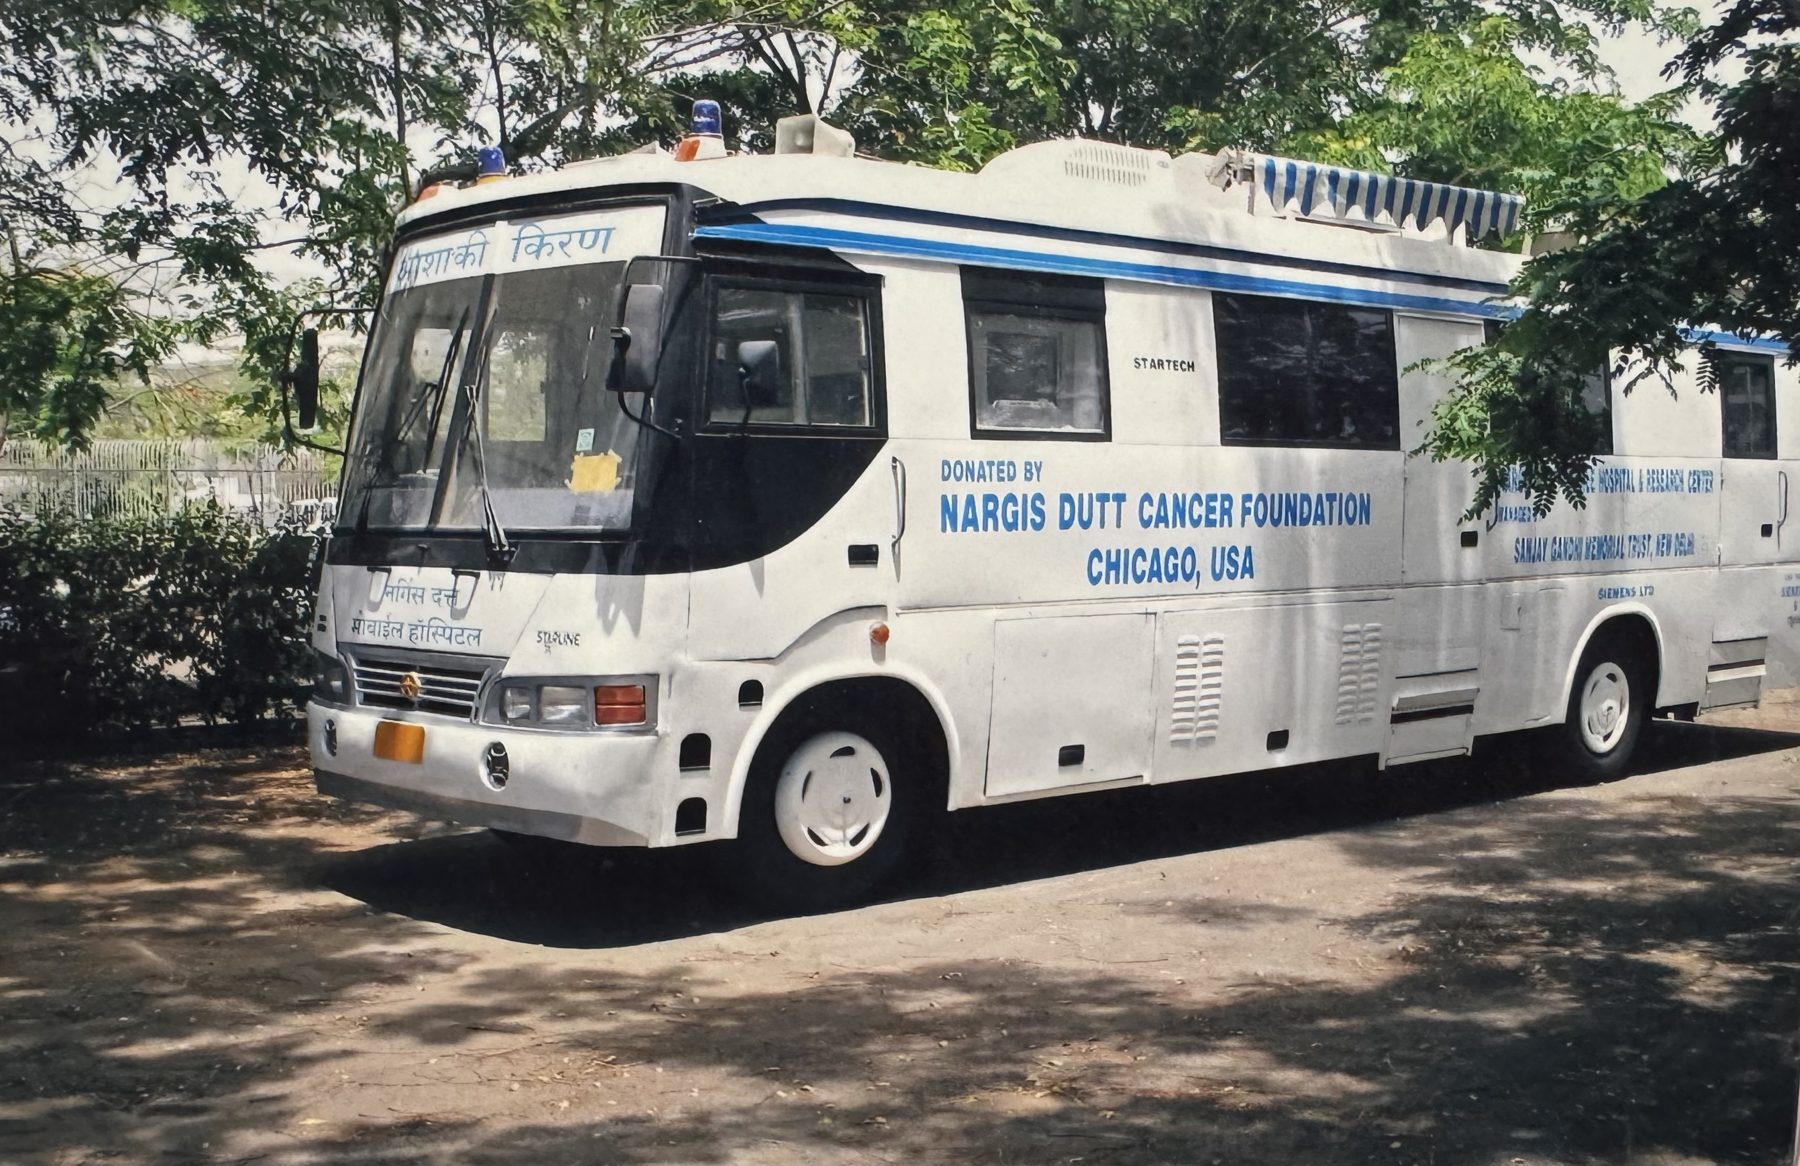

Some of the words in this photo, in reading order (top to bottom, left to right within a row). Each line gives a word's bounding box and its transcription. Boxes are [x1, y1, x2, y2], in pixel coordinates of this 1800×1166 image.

[512, 222, 616, 263] किरण
[1133, 357, 1195, 372] STARTECH
[941, 459, 1017, 483] DONATED
[1024, 460, 1043, 482] BY
[941, 492, 1046, 533] NARGIS
[1058, 493, 1127, 530] DUTT
[1138, 492, 1233, 530] CANCER
[1240, 492, 1371, 529] FOUNDATION
[1087, 546, 1200, 589] CHICAGO,
[1210, 546, 1254, 581] USA
[1598, 586, 1636, 600] SIEMENS
